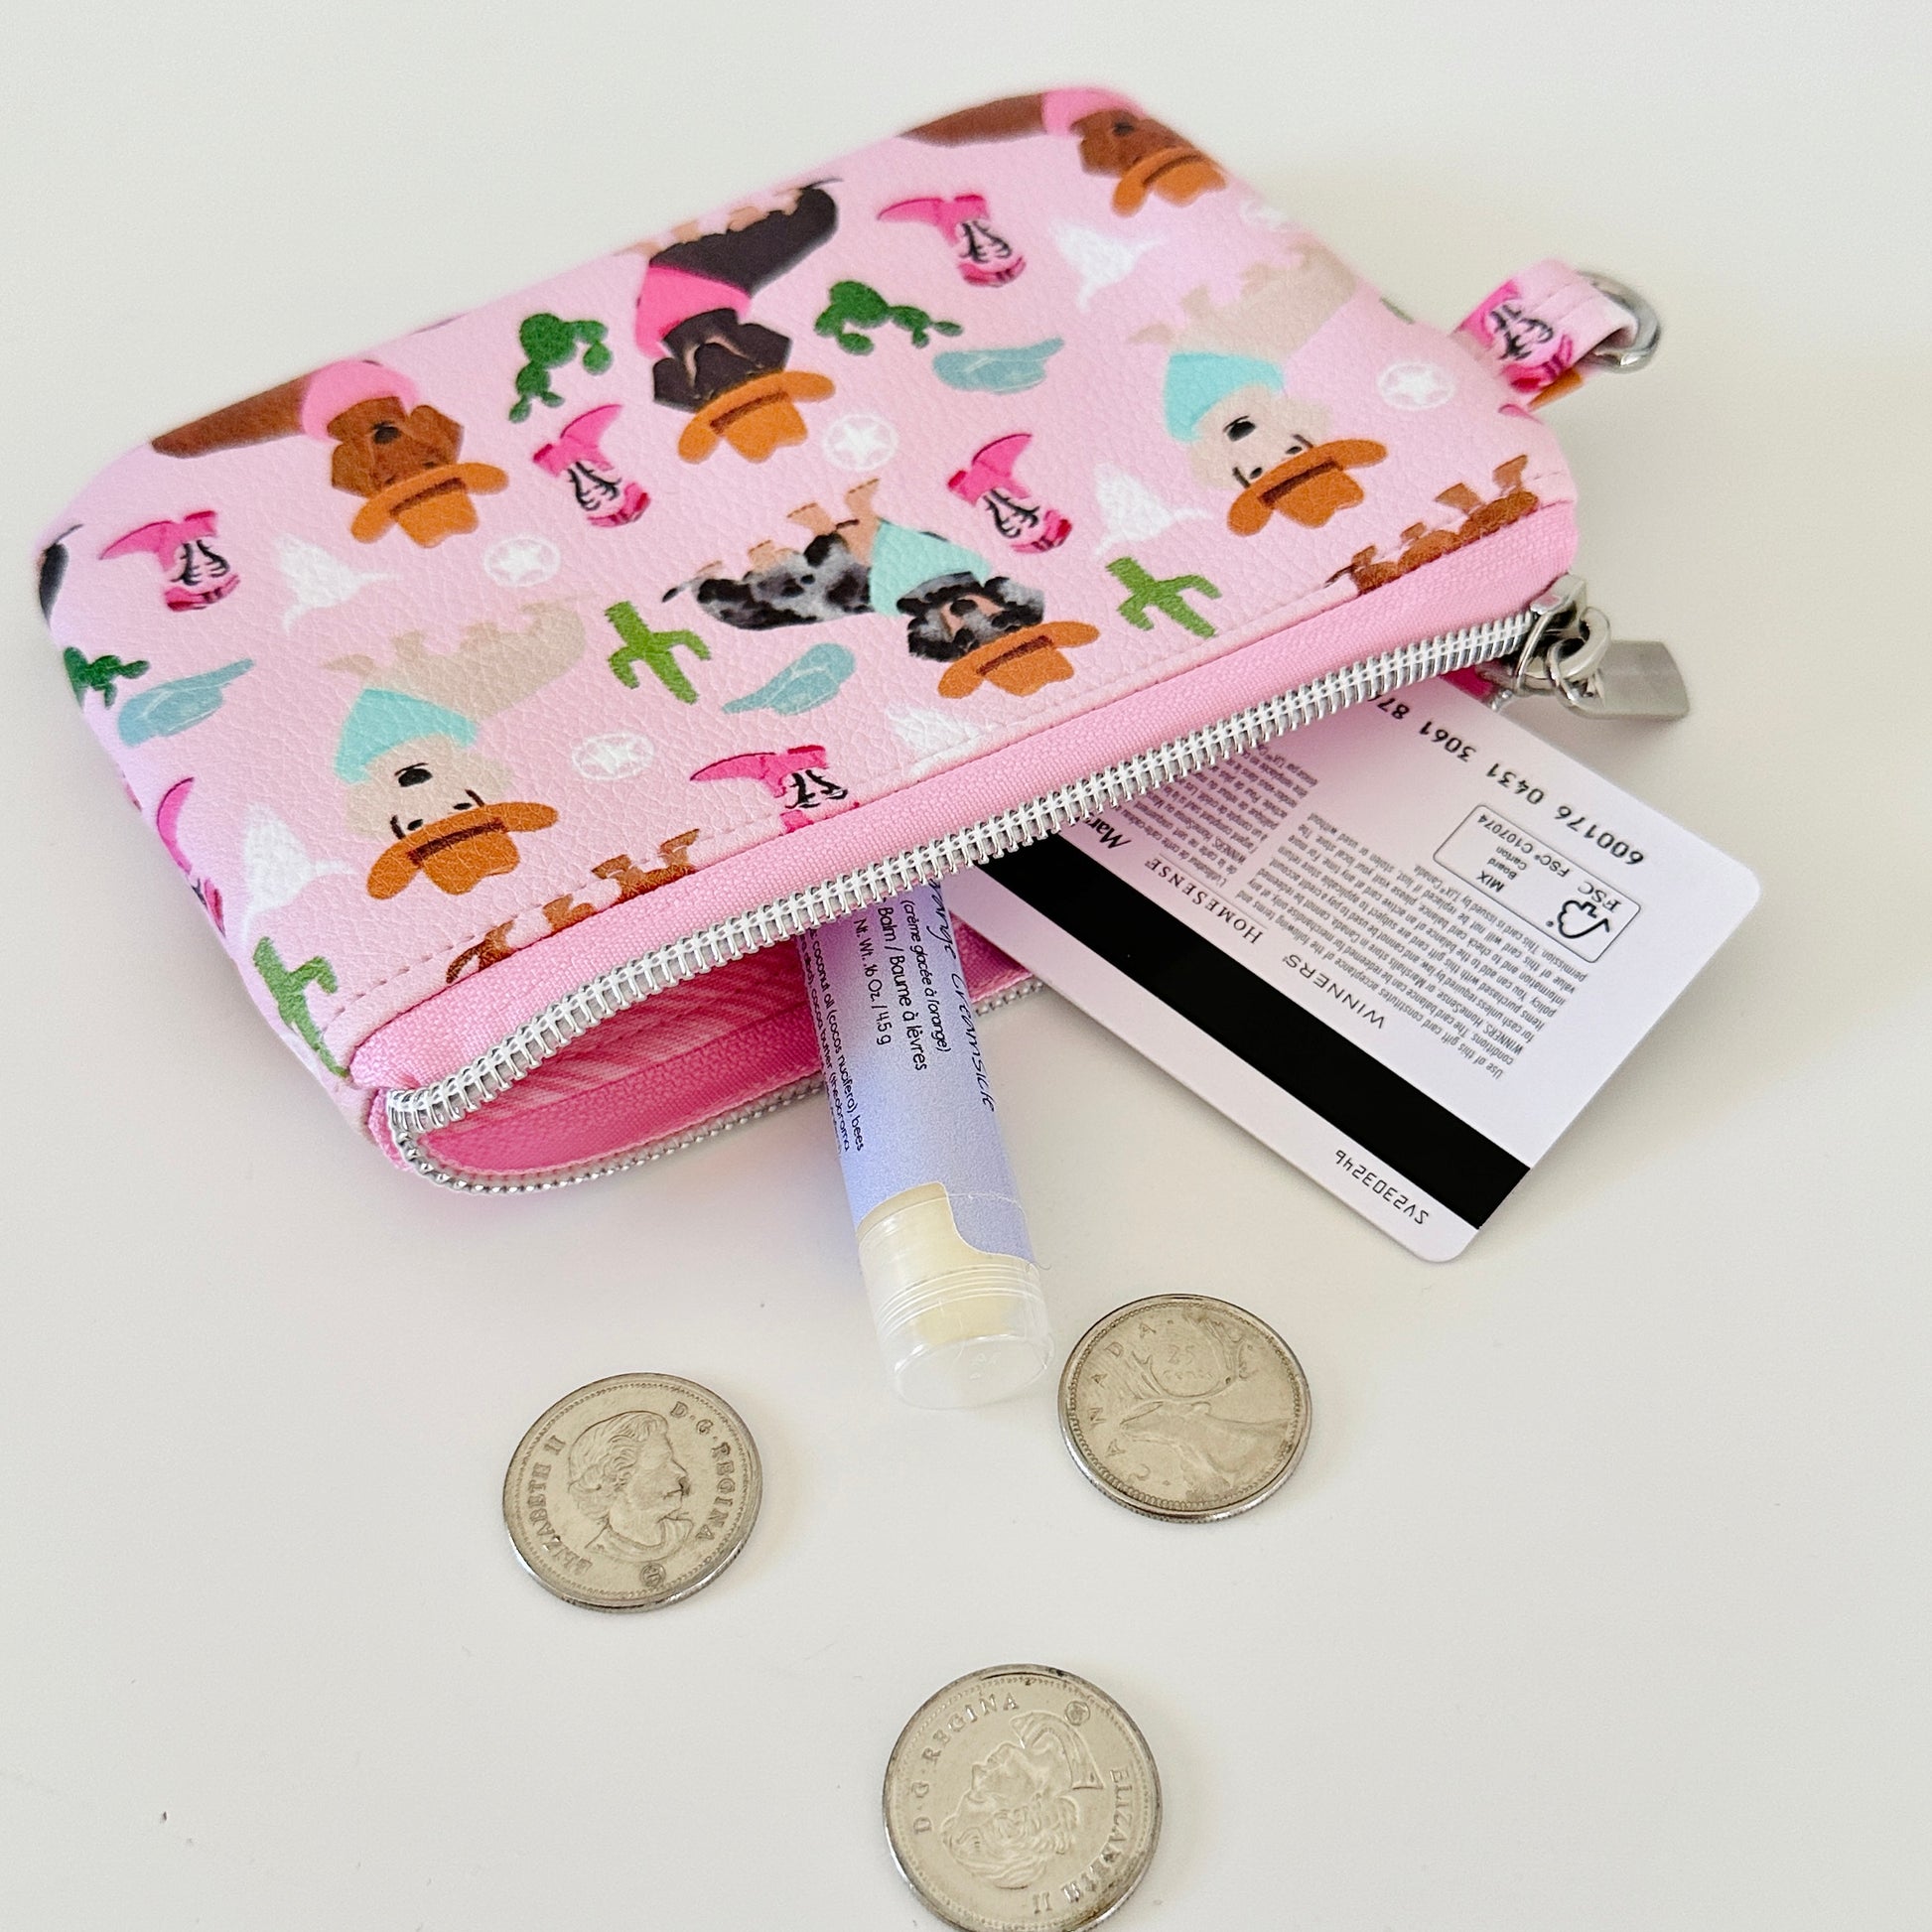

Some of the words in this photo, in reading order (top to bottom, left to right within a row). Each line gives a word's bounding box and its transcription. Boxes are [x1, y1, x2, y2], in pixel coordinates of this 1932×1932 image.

[1418, 720, 1476, 761] 3061
[1486, 762, 1545, 804] 0431
[1298, 823, 1311, 838] The
[1477, 813, 1534, 854] C107074
[1555, 805, 1644, 865] 600176
[1161, 836, 1180, 853] cette
[1288, 834, 1309, 851] more
[1277, 845, 1302, 865] return
[1307, 848, 1321, 861] For
[1333, 849, 1355, 867] local
[1495, 846, 1528, 871] Carton
[1301, 861, 1322, 878] store
[1340, 869, 1356, 883] any
[1353, 862, 1375, 876] your
[1486, 857, 1518, 881] Board
[1246, 878, 1263, 892] any
[1256, 867, 1295, 896] redeemed
[1298, 878, 1322, 897] credit
[1353, 880, 1366, 889] at
[1371, 874, 1390, 889] visit
[1476, 870, 1505, 893] MIX
[1235, 890, 1253, 903] and
[1259, 888, 1271, 897] at
[1293, 893, 1306, 904] be
[1361, 886, 1383, 901] card
[1390, 886, 1419, 905] please
[1577, 881, 1621, 912] FSC
[1252, 900, 1276, 920] terms
[1302, 898, 1331, 920] cannot
[1325, 896, 1343, 909] pay
[1358, 900, 1369, 911] to
[1381, 897, 1407, 916] active
[1459, 895, 1472, 908] by
[918, 878, 956, 960] range
[1339, 905, 1350, 917] to
[1346, 911, 1369, 928] used
[1366, 906, 1398, 930] subject
[1404, 913, 1418, 924] an
[1467, 902, 1498, 924] issued
[877, 906, 897, 942] Balm
[899, 898, 921, 942] (crème
[1286, 905, 1334, 942] merchandise
[1414, 921, 1427, 931] of
[1495, 919, 1506, 929] is
[1366, 924, 1379, 937] be
[1396, 926, 1412, 939] are
[1447, 924, 1467, 940] card
[1501, 924, 1524, 940] card
[1310, 940, 1324, 955] the
[1332, 938, 1345, 951] for
[1358, 937, 1369, 947] in
[1375, 930, 1405, 953] cannot
[1408, 935, 1430, 951] card
[1425, 927, 1457, 953] balance
[1466, 937, 1492, 956] check
[1521, 936, 1540, 955] This
[859, 937, 874, 961] Wt.
[1322, 950, 1335, 960] of
[1367, 943, 1390, 961] store
[1401, 949, 1421, 963] and
[1427, 947, 1447, 962] gift
[1455, 948, 1471, 963] the
[908, 944, 933, 985] glacée
[1341, 945, 1383, 975] redeemed
[1443, 958, 1460, 974] this
[1469, 957, 1481, 969] to
[1491, 953, 1502, 965] to
[1499, 960, 1519, 974] and
[1333, 957, 1380, 991] acceptance
[1380, 971, 1394, 984] be
[1388, 957, 1427, 988] Marshalls
[1434, 969, 1447, 983] by
[1459, 969, 1479, 985] with
[1477, 964, 1497, 979] add
[889, 954, 912, 1007] Baume
[1391, 978, 1408, 992] can
[1424, 983, 1437, 993] or
[1495, 974, 1513, 990] can
[1518, 971, 1566, 1006] information
[923, 987, 937, 997] à
[1442, 976, 1478, 1003] required
[1476, 982, 1523, 1014] purchased
[1511, 985, 1527, 1002] You
[1377, 988, 1424, 1022] constitutes
[1405, 988, 1438, 1015] balance
[1475, 998, 1504, 1020] unless
[876, 1011, 893, 1033] 4.5
[901, 1010, 919, 1022] à
[1433, 1008, 1455, 1025] card
[1519, 1010, 1545, 1032] Items
[1420, 1019, 1443, 1035] card
[1452, 1021, 1469, 1037] The
[1501, 1016, 1523, 1034] cash
[876, 1034, 892, 1045] g
[1441, 1032, 1460, 1045] gift
[1520, 1030, 1535, 1043] for
[810, 939, 830, 992] coconut
[825, 1009, 842, 1054] (cocos
[851, 1115, 864, 1152] bees
[905, 1025, 927, 1070] lèvres
[1457, 1042, 1475, 1059] this
[1472, 1055, 1487, 1065] of
[1485, 1062, 1504, 1079] Use
[1335, 1149, 1429, 1225] SV2303246
[544, 1435, 566, 1455] II
[527, 1462, 593, 1576] ELIZABETH
